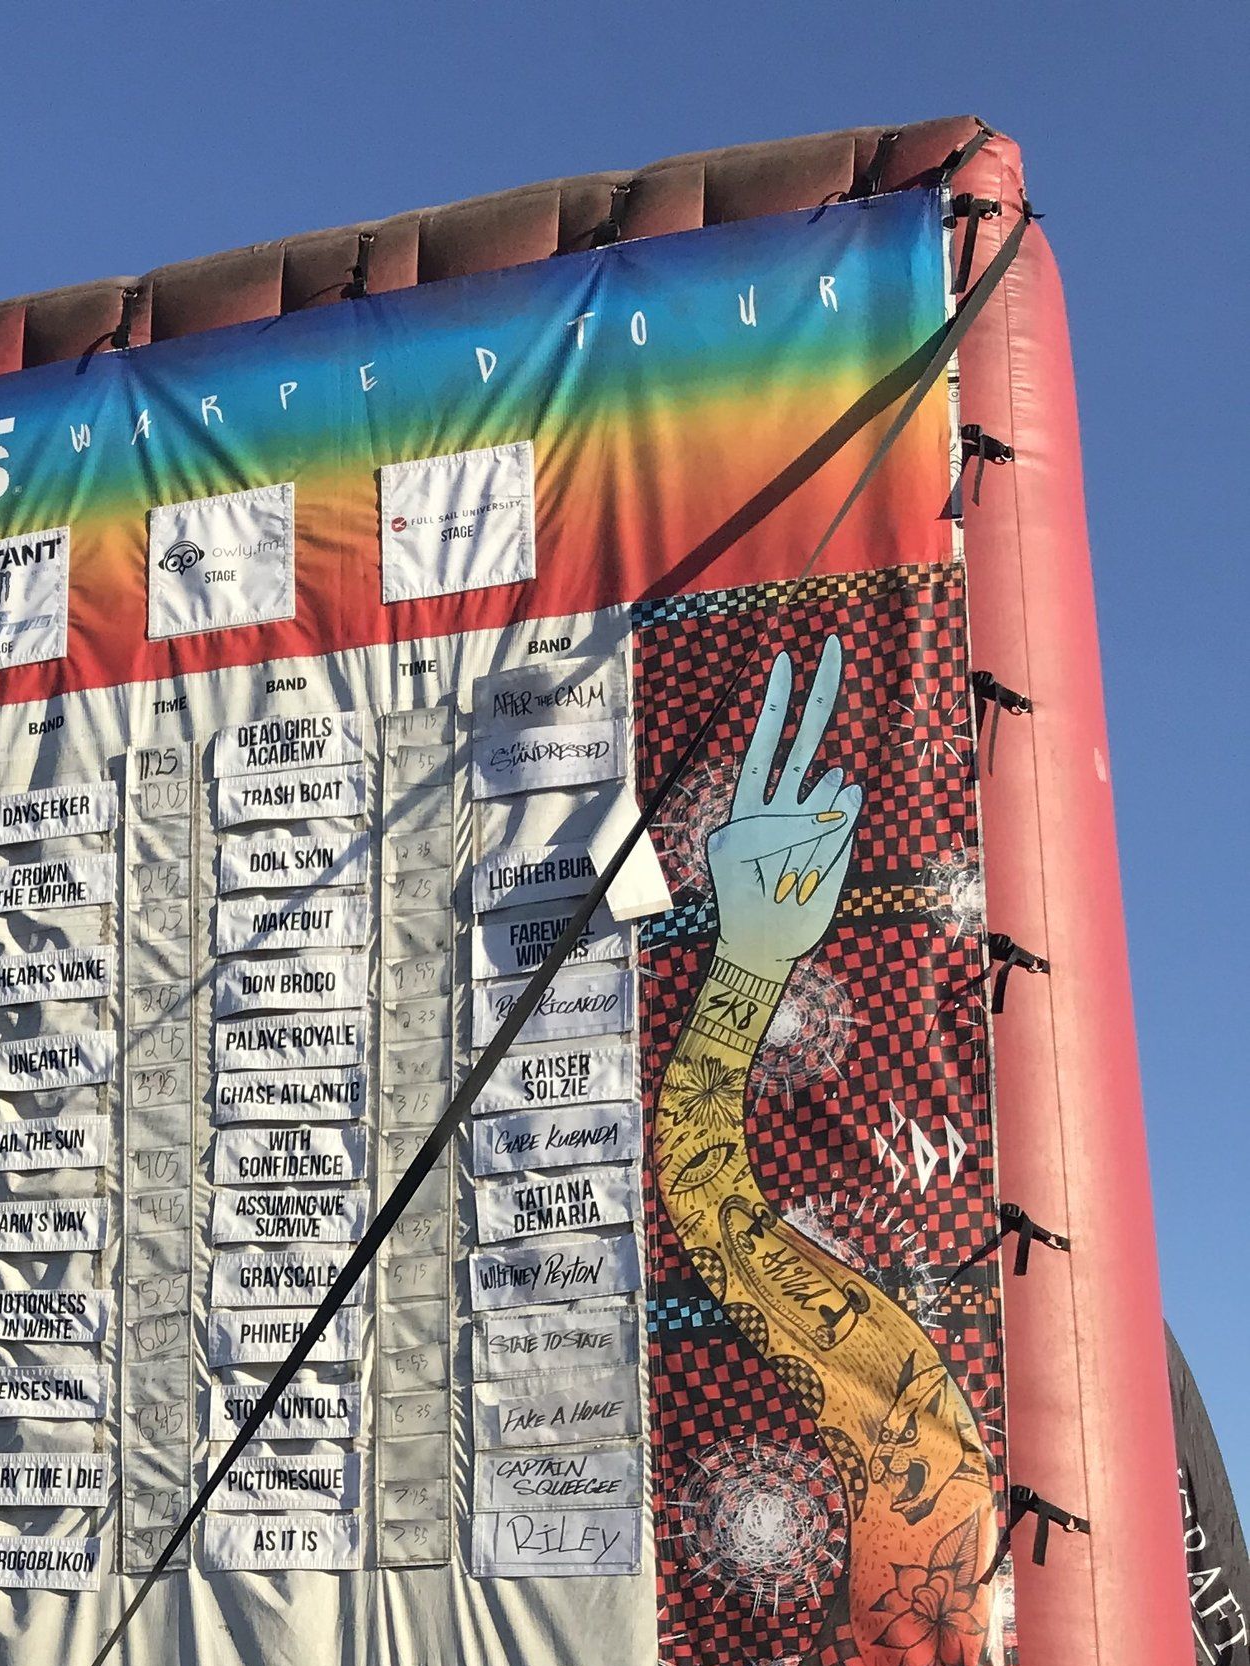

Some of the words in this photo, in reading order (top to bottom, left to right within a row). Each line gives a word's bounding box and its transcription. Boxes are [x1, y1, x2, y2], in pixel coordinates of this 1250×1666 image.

[71, 346, 498, 454] WARPED
[566, 273, 838, 350] TOUR
[411, 516, 434, 526] FULL
[439, 512, 458, 522] SAIL
[462, 501, 521, 518] UNIVERSITY
[441, 525, 473, 542] STAGE
[205, 570, 236, 583] STAGE
[265, 677, 307, 695] BAND
[153, 695, 188, 715] TIME
[238, 725, 281, 748] DEAD
[284, 718, 332, 742] GIRLS
[246, 741, 326, 767] ACADEMY
[242, 785, 295, 806] TRASH
[300, 780, 343, 802] BOAT
[3, 795, 89, 827] DAYSEEKER
[250, 851, 289, 872] DOLL
[295, 848, 334, 869] SKIN
[12, 865, 67, 887] CROWN
[28, 882, 86, 905] EMPIRE
[253, 910, 333, 934] MAKEOUT
[242, 975, 275, 995] DON
[280, 972, 335, 993] BROCO
[226, 1027, 287, 1051] PALAYE
[292, 1025, 355, 1049] ROYALE
[8, 1046, 80, 1075] UNEARTH
[521, 1054, 590, 1079] KAISER
[220, 1084, 276, 1106] CHASE
[280, 1081, 361, 1104] ATLANTIC
[523, 1076, 588, 1102] SOLZIE
[269, 1129, 311, 1152] WITH
[239, 1154, 342, 1178] CONFIDENCE
[515, 1180, 594, 1204] TATIANA
[235, 1195, 318, 1216] ASSUMING
[320, 1194, 345, 1216] WE
[53, 1211, 86, 1233] WAY
[255, 1217, 320, 1237] SURVIVE
[513, 1202, 601, 1234] DEMARIA
[240, 1265, 338, 1288] GRAYSCALE
[54, 1379, 89, 1401] FAIL
[227, 1468, 343, 1492] PICTURESQUE
